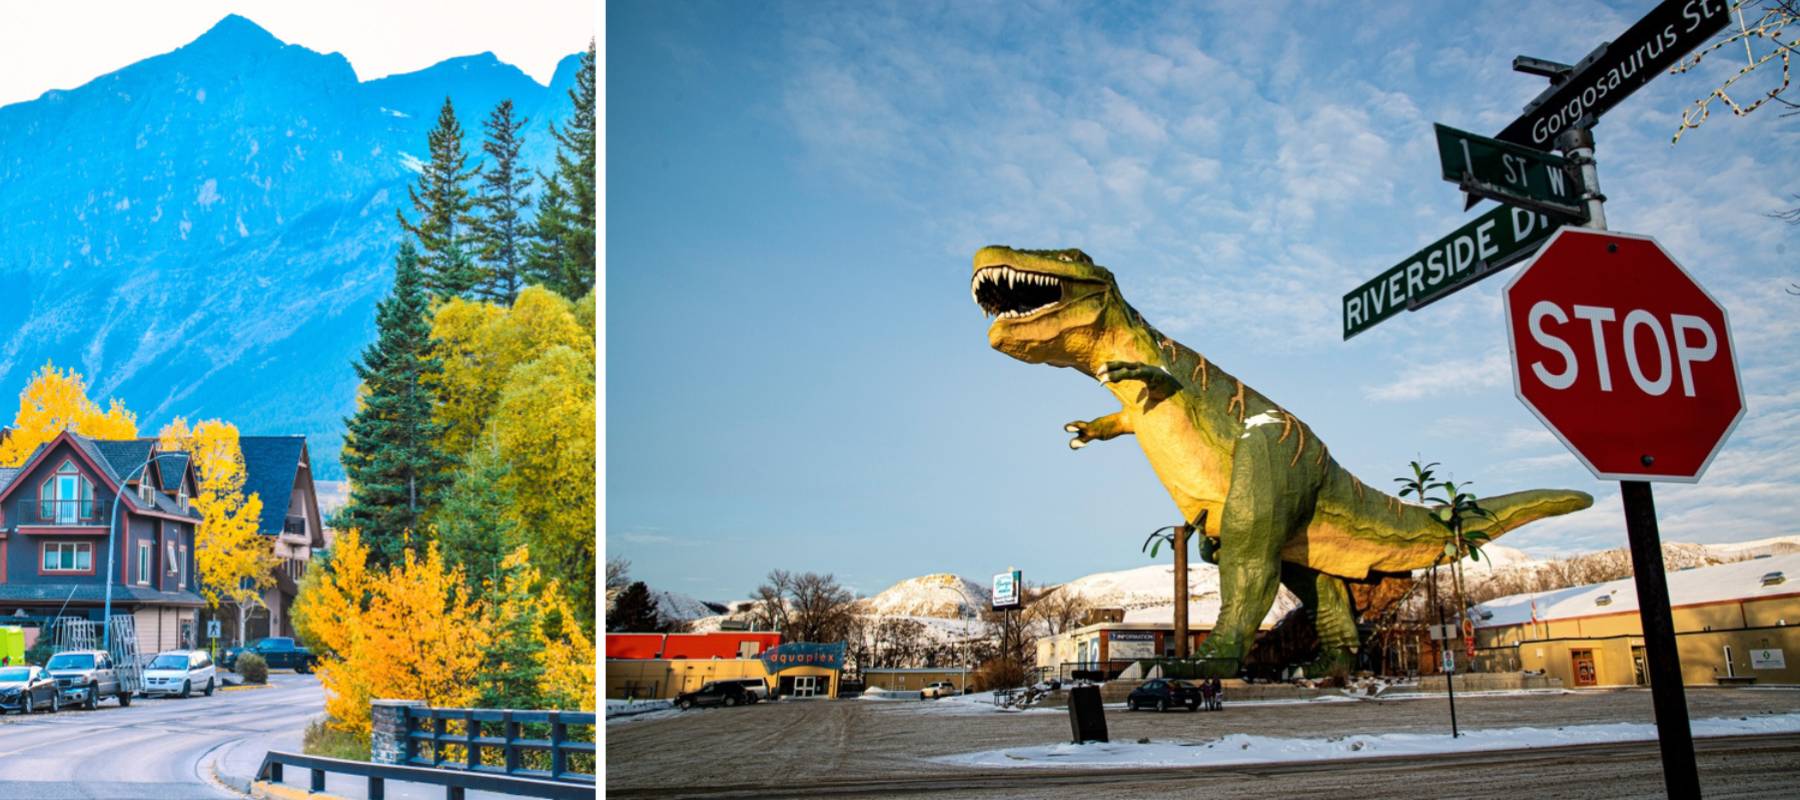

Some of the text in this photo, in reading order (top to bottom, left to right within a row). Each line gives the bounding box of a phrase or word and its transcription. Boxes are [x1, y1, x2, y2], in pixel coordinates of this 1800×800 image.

[1532, 0, 1722, 145] Gorgosaurus St.
[1459, 138, 1565, 197] 1 ST W
[1346, 206, 1549, 331] RIVERSIDE D
[1528, 300, 1718, 397] STOP
[770, 652, 834, 665] aquaplex
